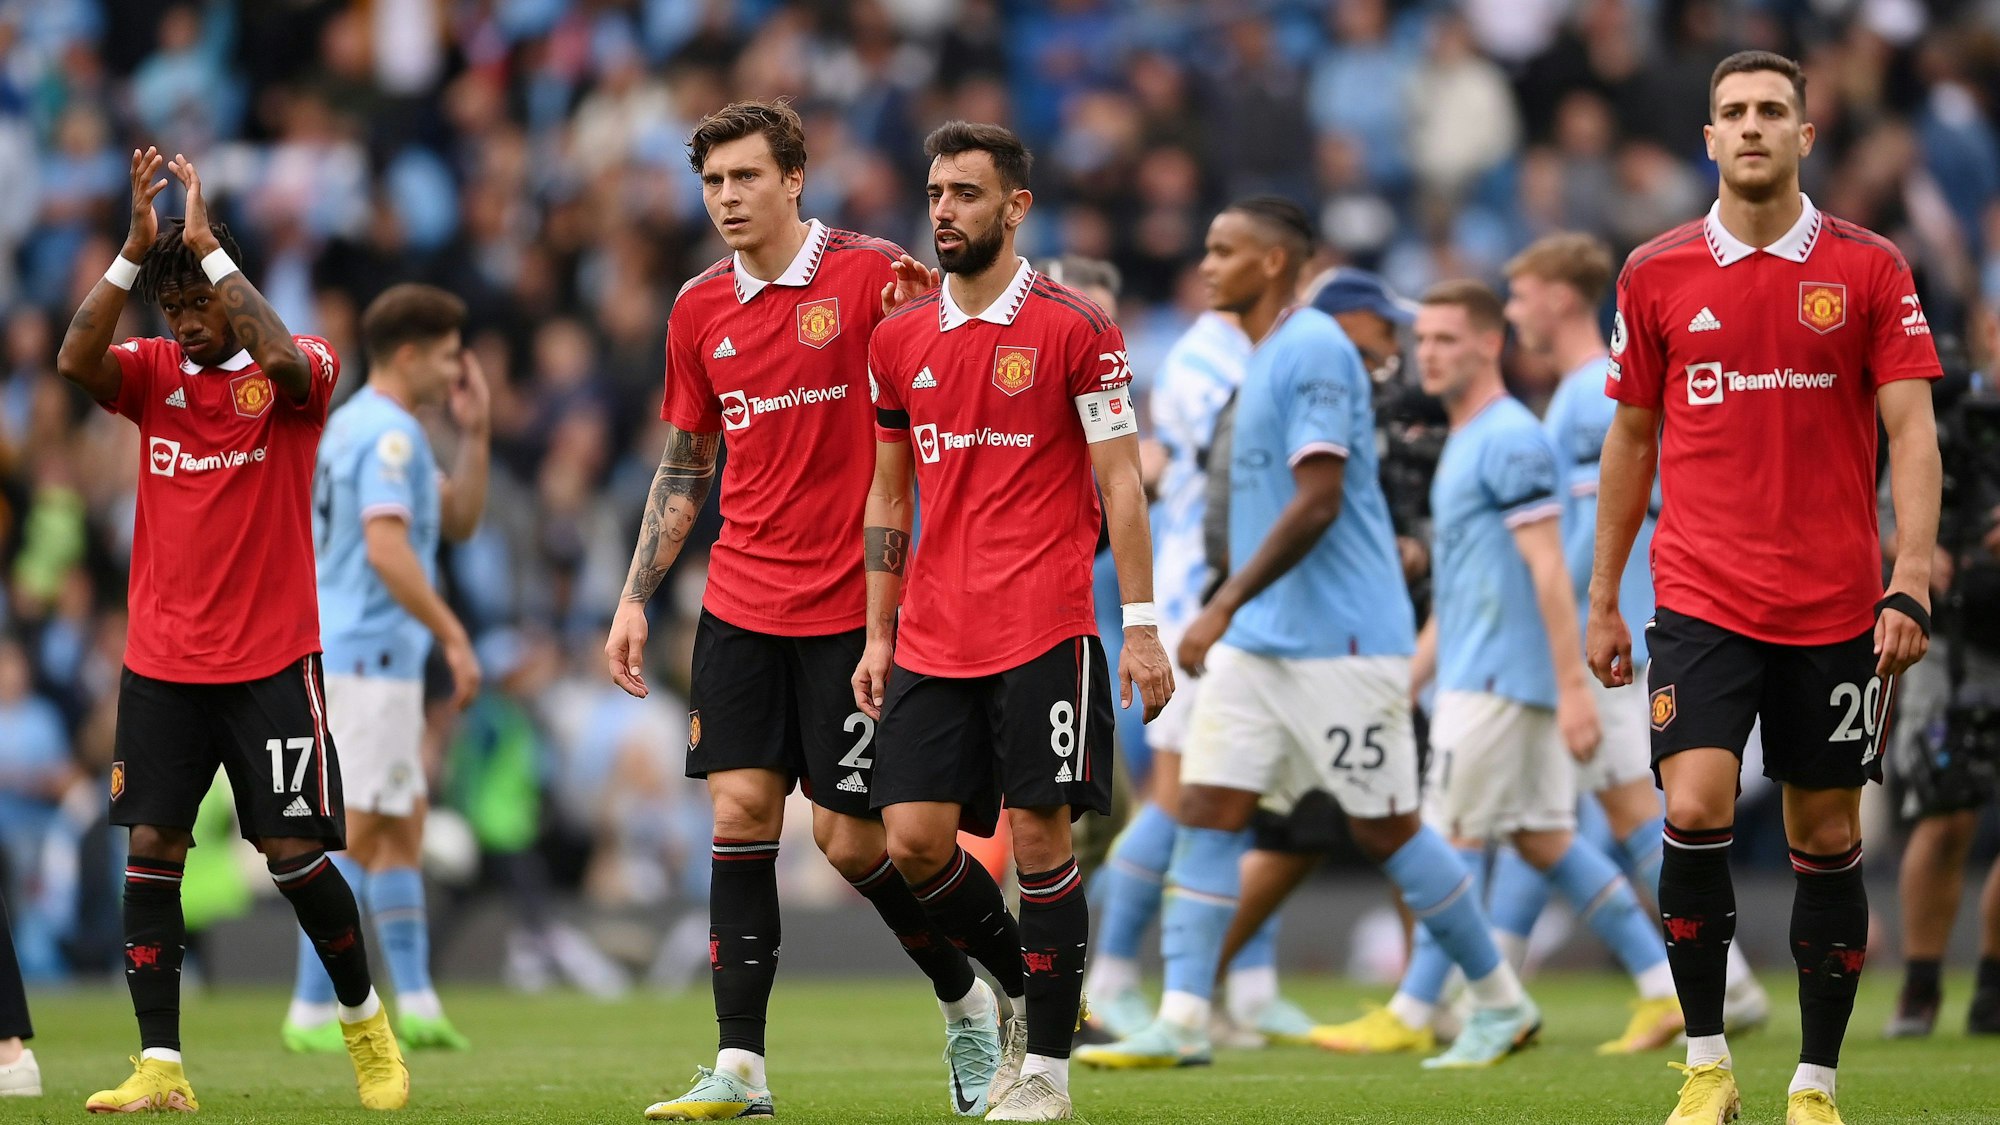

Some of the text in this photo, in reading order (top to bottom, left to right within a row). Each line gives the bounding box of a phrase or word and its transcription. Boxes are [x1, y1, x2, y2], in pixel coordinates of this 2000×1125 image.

[713, 348, 737, 360] adidas
[911, 379, 937, 389] adidas
[1724, 368, 1837, 391] TeamViewer
[165, 397, 187, 409] adidas
[748, 384, 849, 415] TeamViewer
[179, 446, 268, 471] TeamViewer
[1828, 675, 1881, 742] 20
[838, 711, 875, 769] 2
[1049, 700, 1075, 758] 8
[1326, 724, 1385, 769] 25
[266, 737, 314, 794] 17
[836, 782, 868, 793] adidas
[283, 808, 312, 817] adidas
